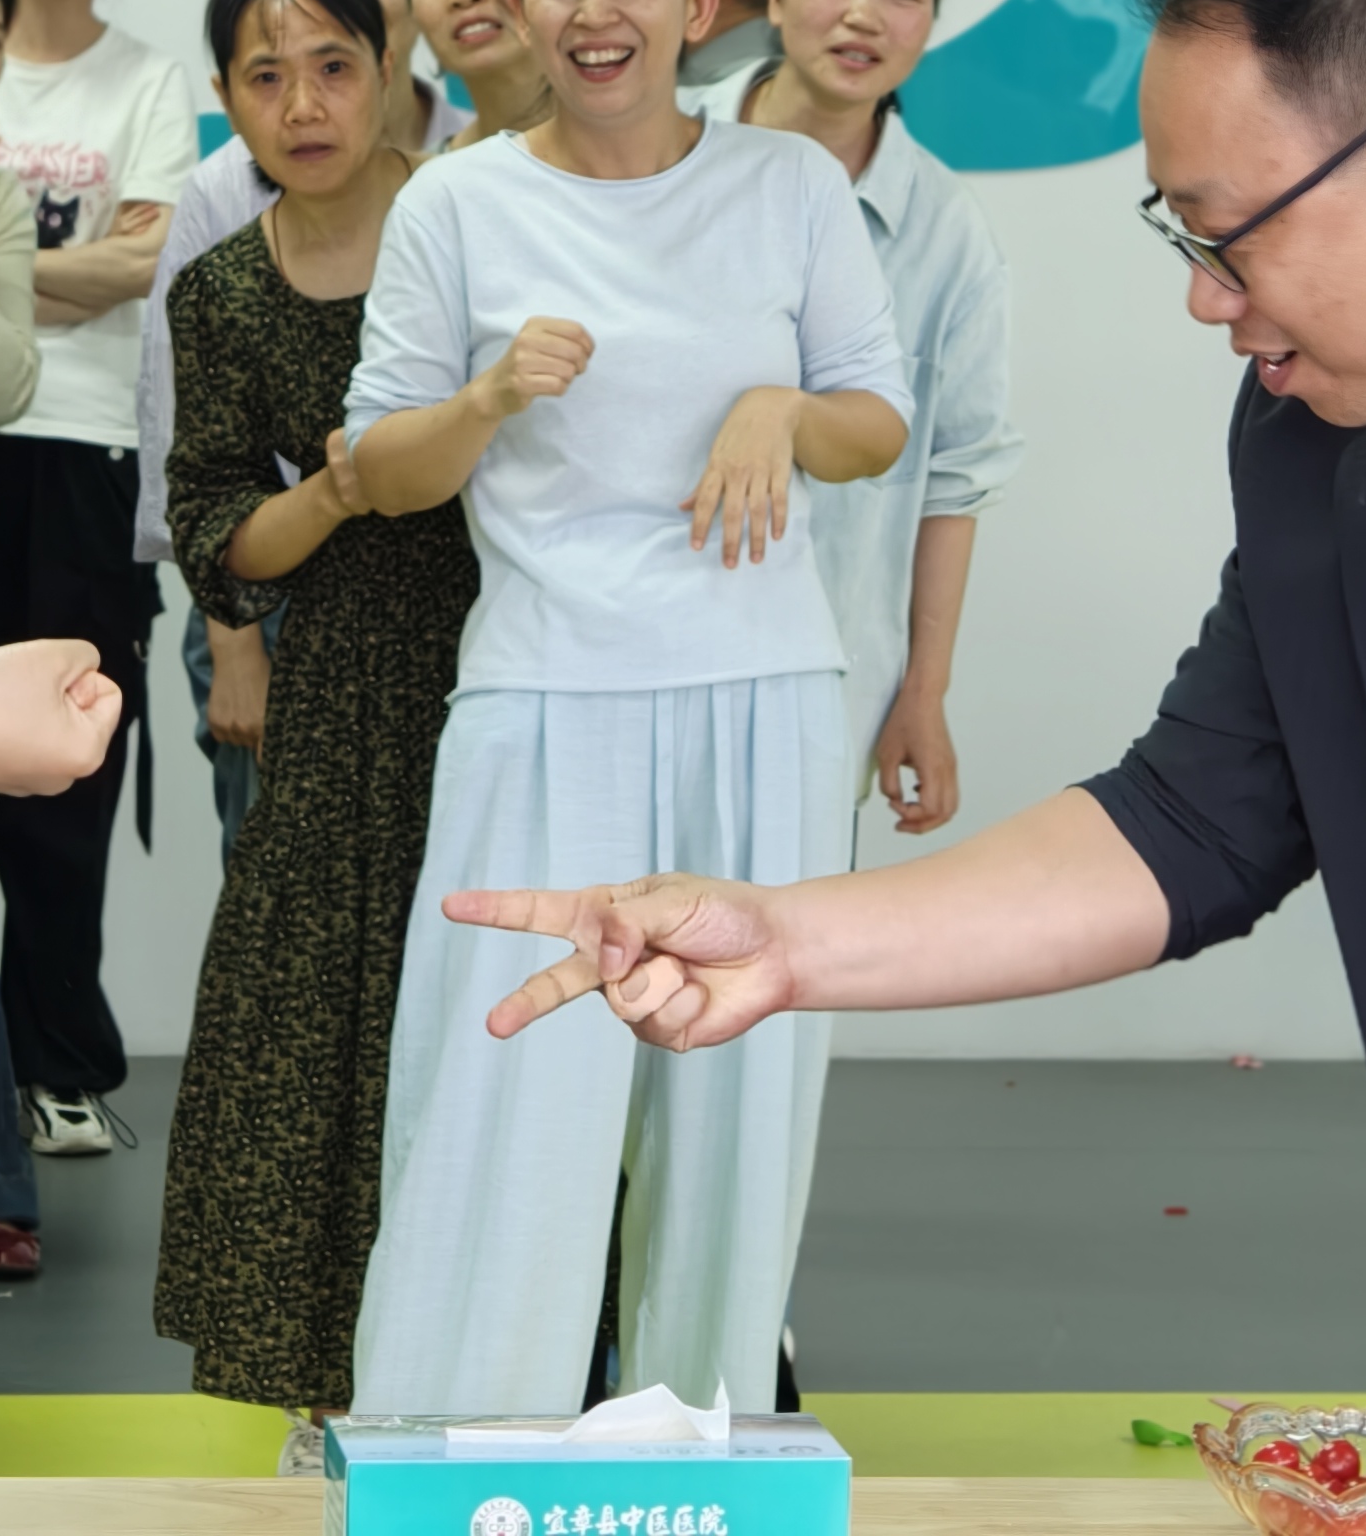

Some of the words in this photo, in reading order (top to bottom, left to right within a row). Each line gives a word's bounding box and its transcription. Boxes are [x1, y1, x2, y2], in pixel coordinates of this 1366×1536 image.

[542, 1504, 729, 1536] 宜章县中医医院
